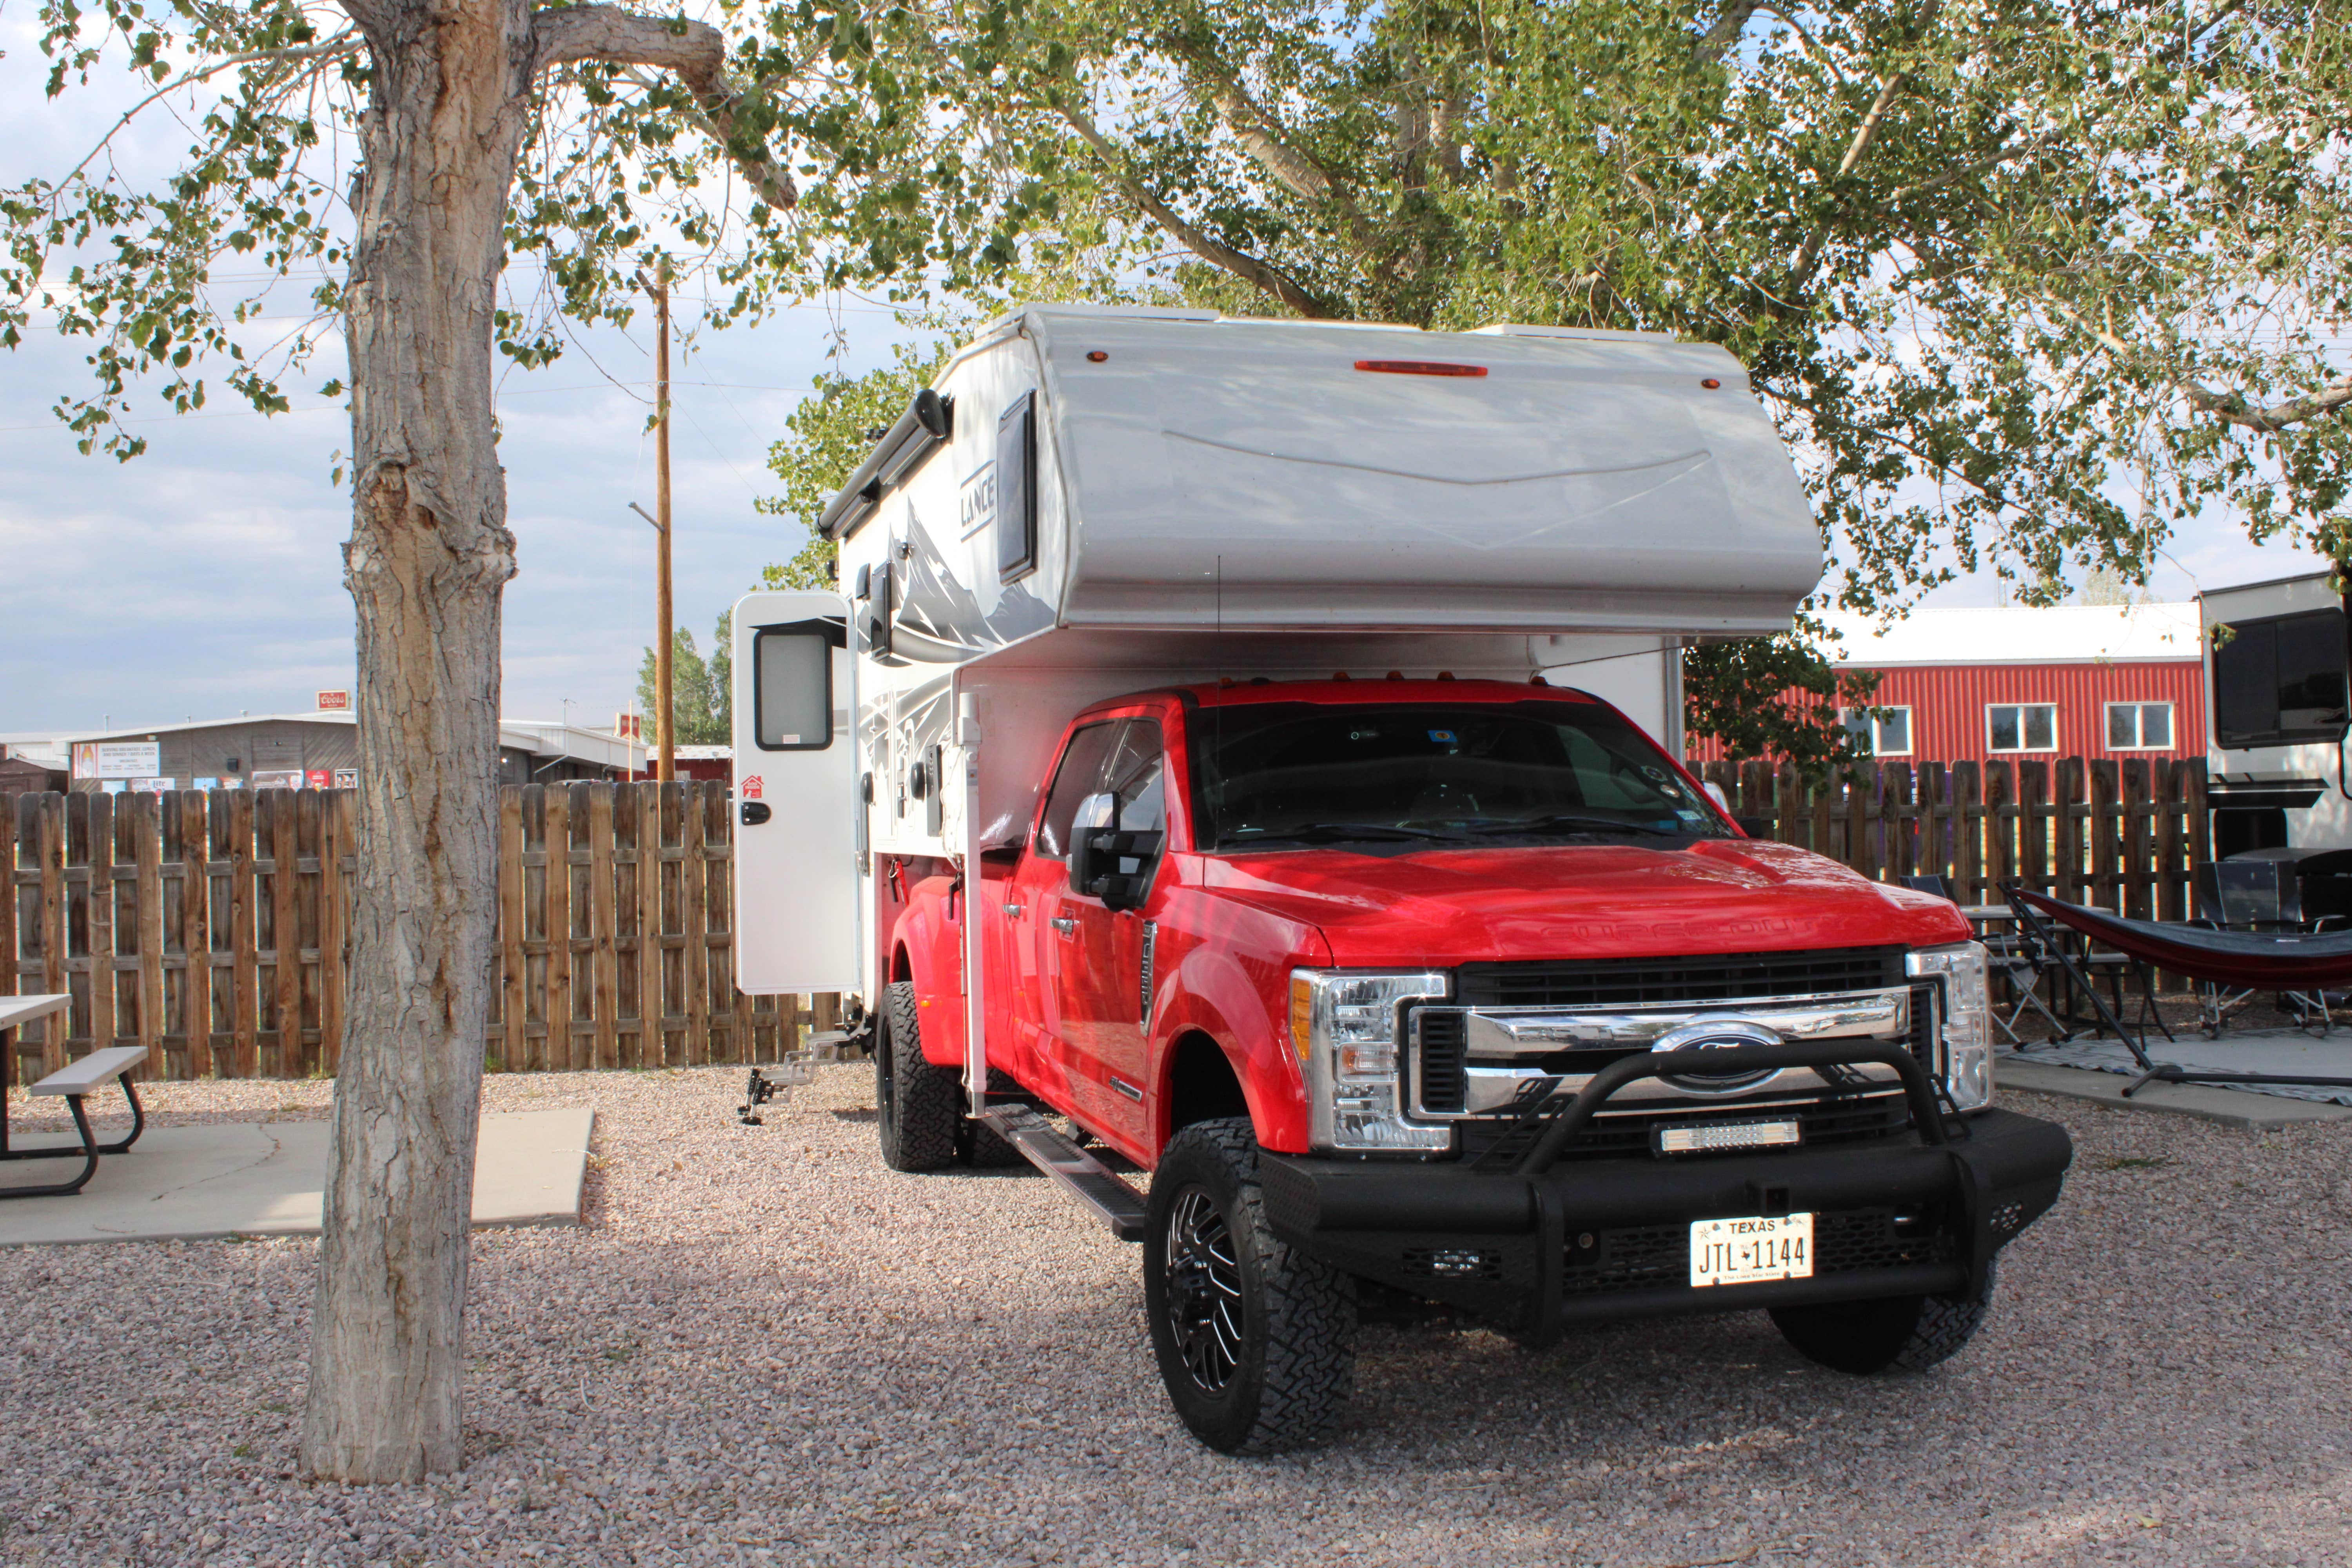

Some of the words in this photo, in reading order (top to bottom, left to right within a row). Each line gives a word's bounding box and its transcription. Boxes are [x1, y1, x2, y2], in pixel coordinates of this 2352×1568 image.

[961, 473, 994, 528] LANCE
[321, 694, 345, 704] Coors
[1729, 1220, 1775, 1234] TEXAS
